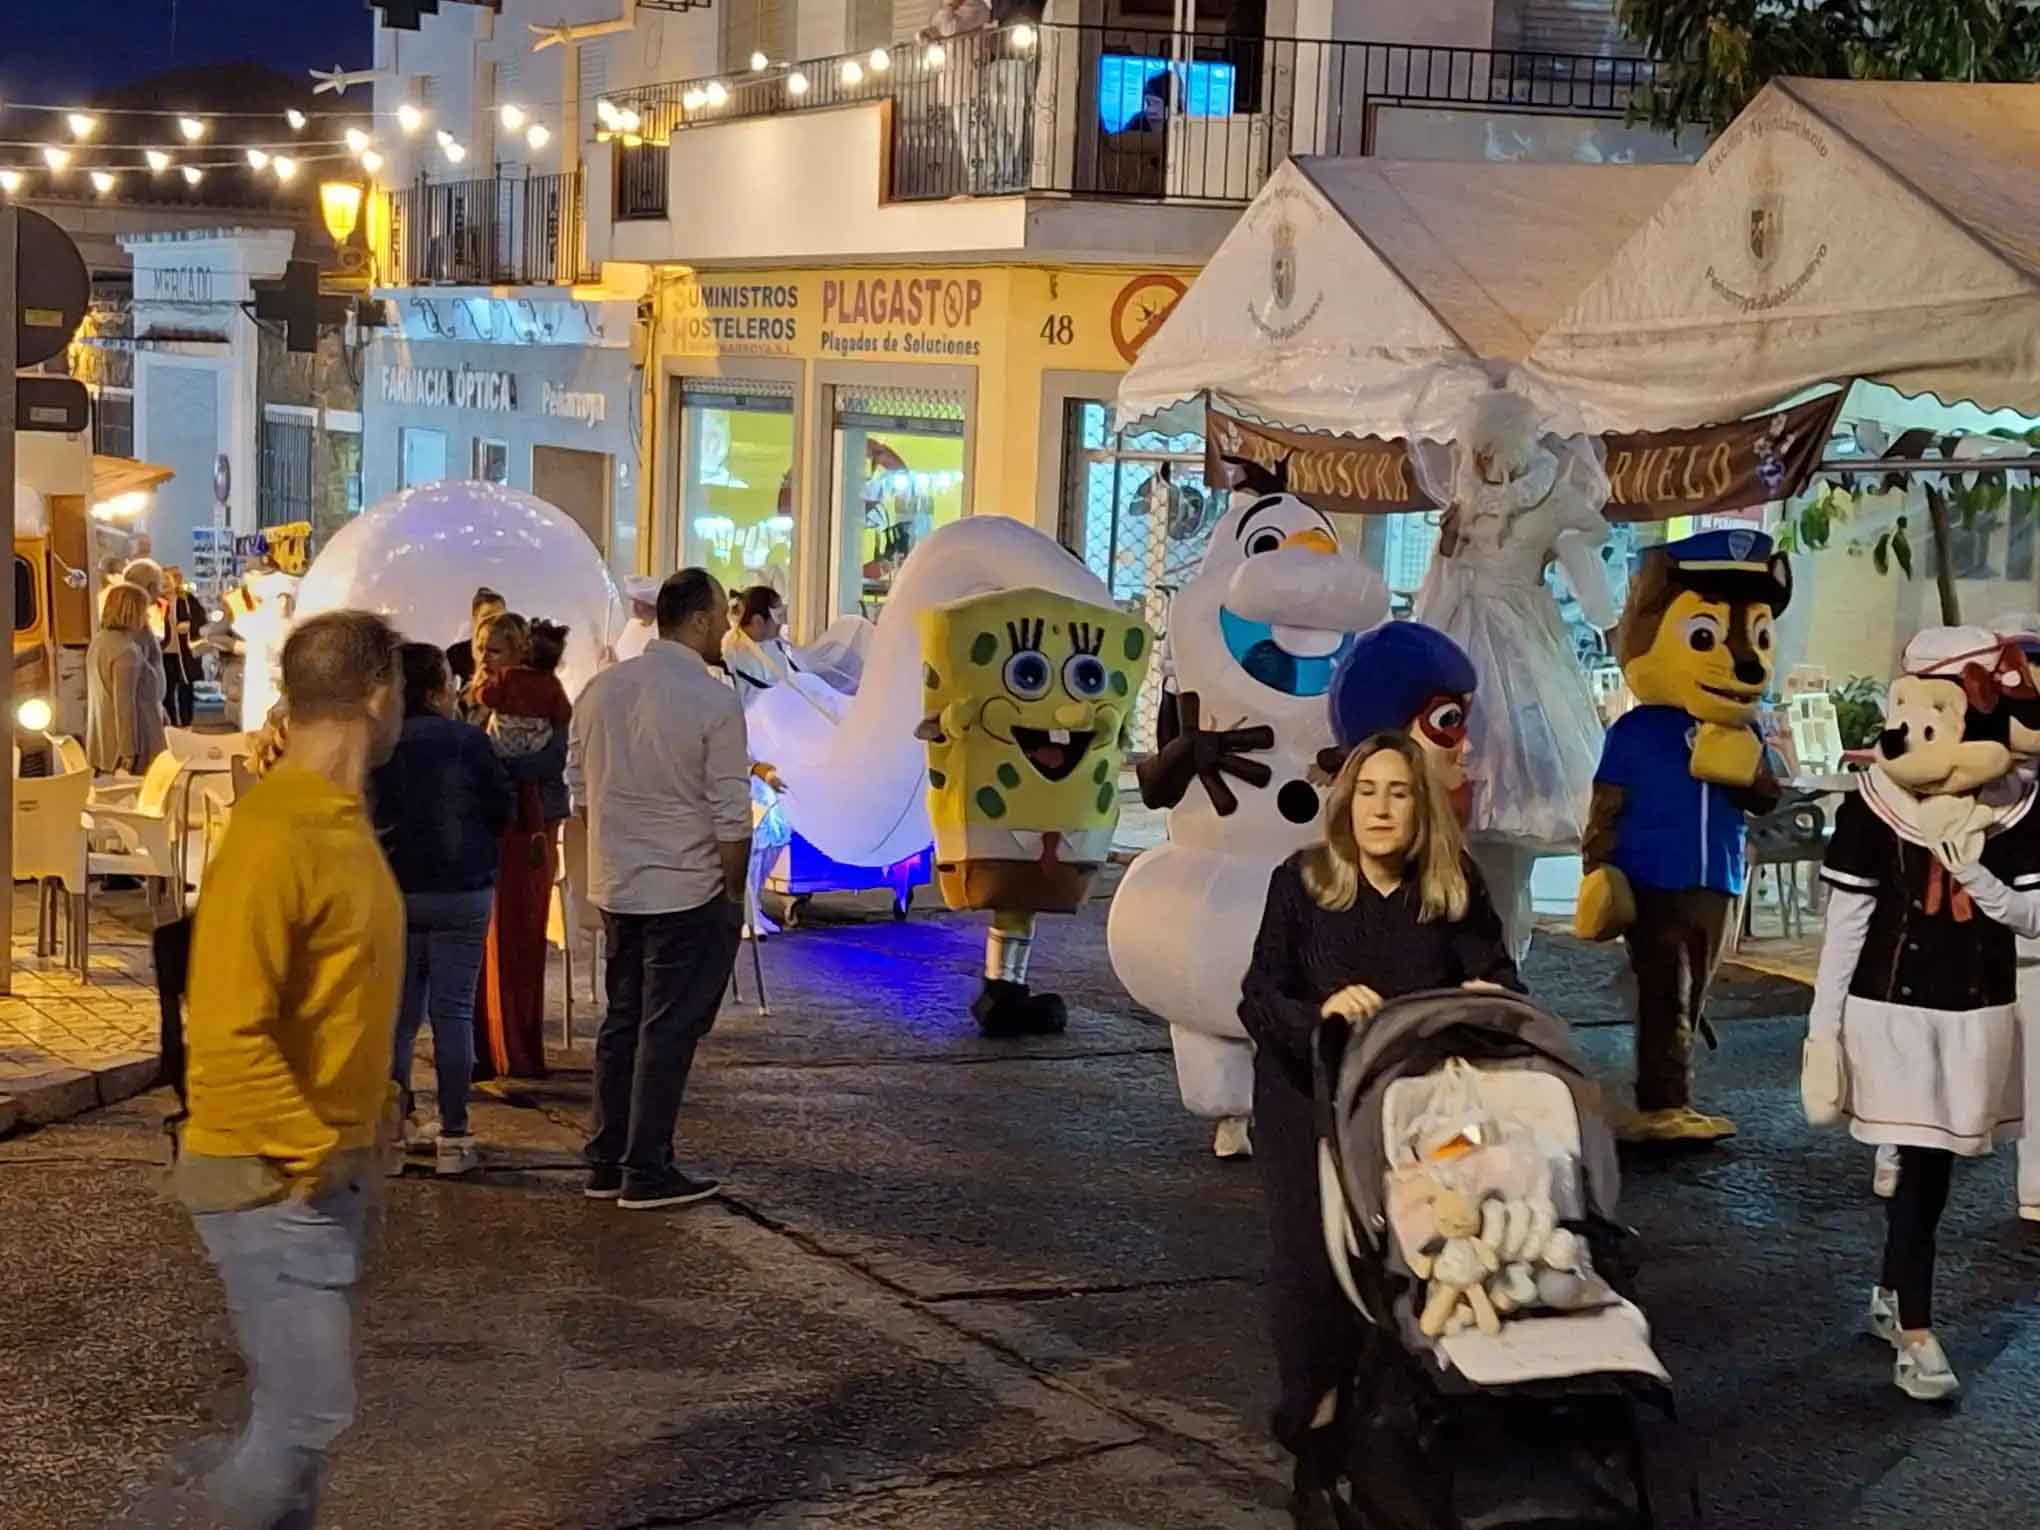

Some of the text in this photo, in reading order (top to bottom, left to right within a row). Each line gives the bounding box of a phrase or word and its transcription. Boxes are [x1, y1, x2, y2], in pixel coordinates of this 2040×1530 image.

[820, 330, 981, 356] Plagados de Soluciones
[1040, 314, 1075, 345] 48
[381, 362, 513, 411] FARMACIA ÓPTICA
